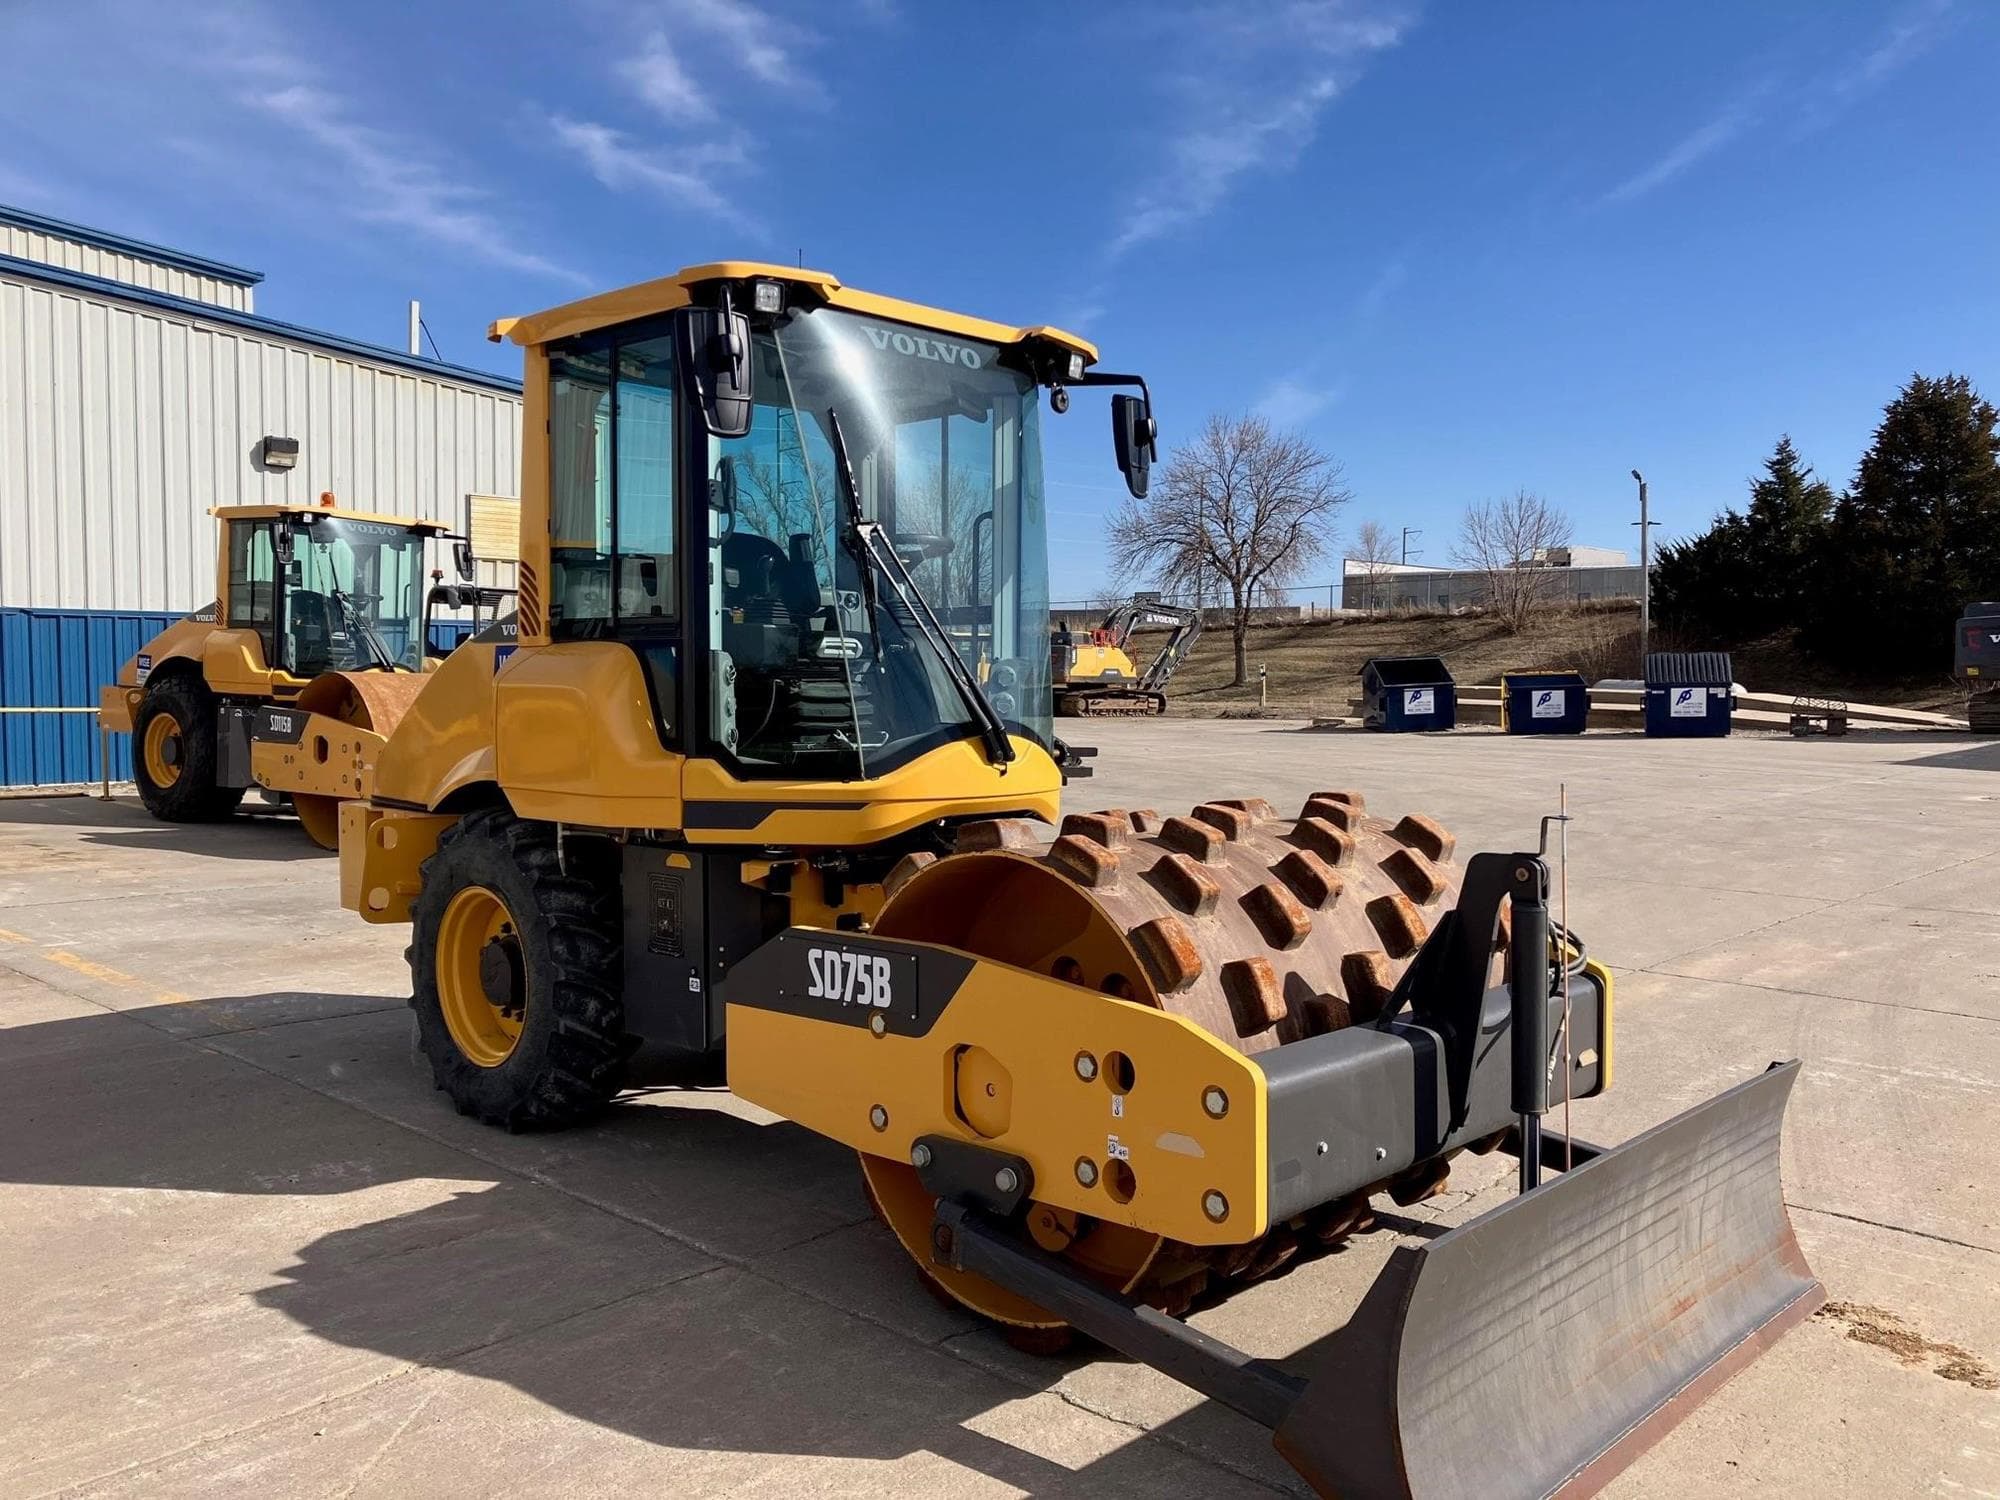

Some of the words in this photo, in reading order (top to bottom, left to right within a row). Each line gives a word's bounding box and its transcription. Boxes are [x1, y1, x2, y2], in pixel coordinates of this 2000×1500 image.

[860, 326, 981, 370] VOLVO
[347, 523, 397, 536] VOLVO
[1152, 614, 1180, 625] VOLVO
[808, 948, 892, 1008] SD75B
